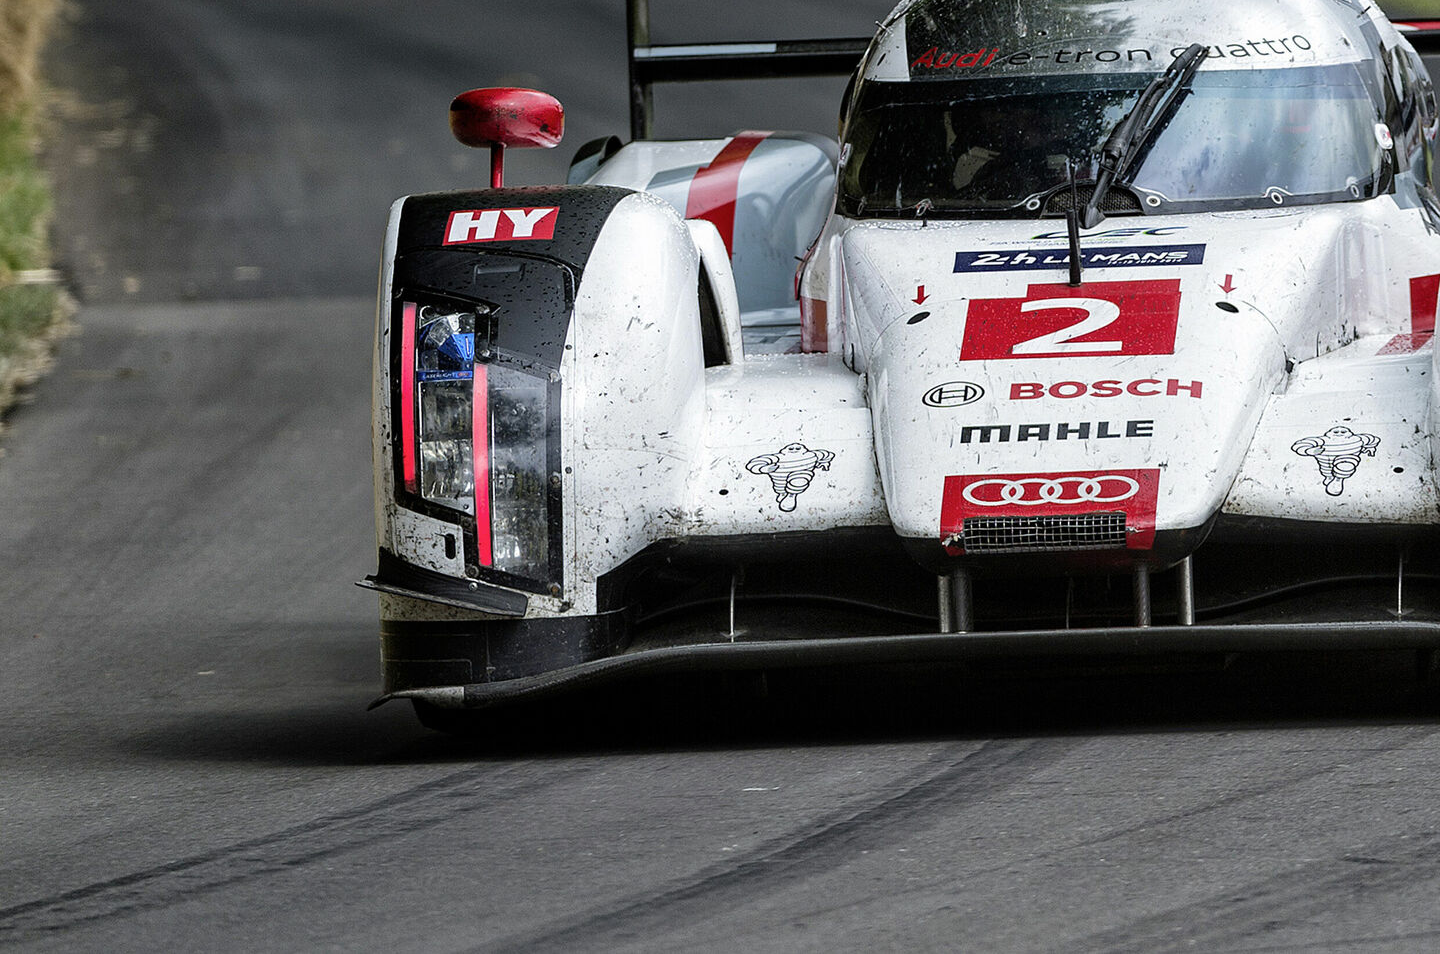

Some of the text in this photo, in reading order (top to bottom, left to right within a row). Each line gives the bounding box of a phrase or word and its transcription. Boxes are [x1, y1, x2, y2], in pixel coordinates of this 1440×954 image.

[911, 46, 999, 69] Audi
[1008, 45, 1153, 66] e-tron
[448, 208, 554, 242] HY
[1090, 251, 1189, 262] MANS
[1011, 298, 1123, 355] 2
[1009, 378, 1203, 400] BOSCH
[960, 420, 1154, 444] MAHLE
